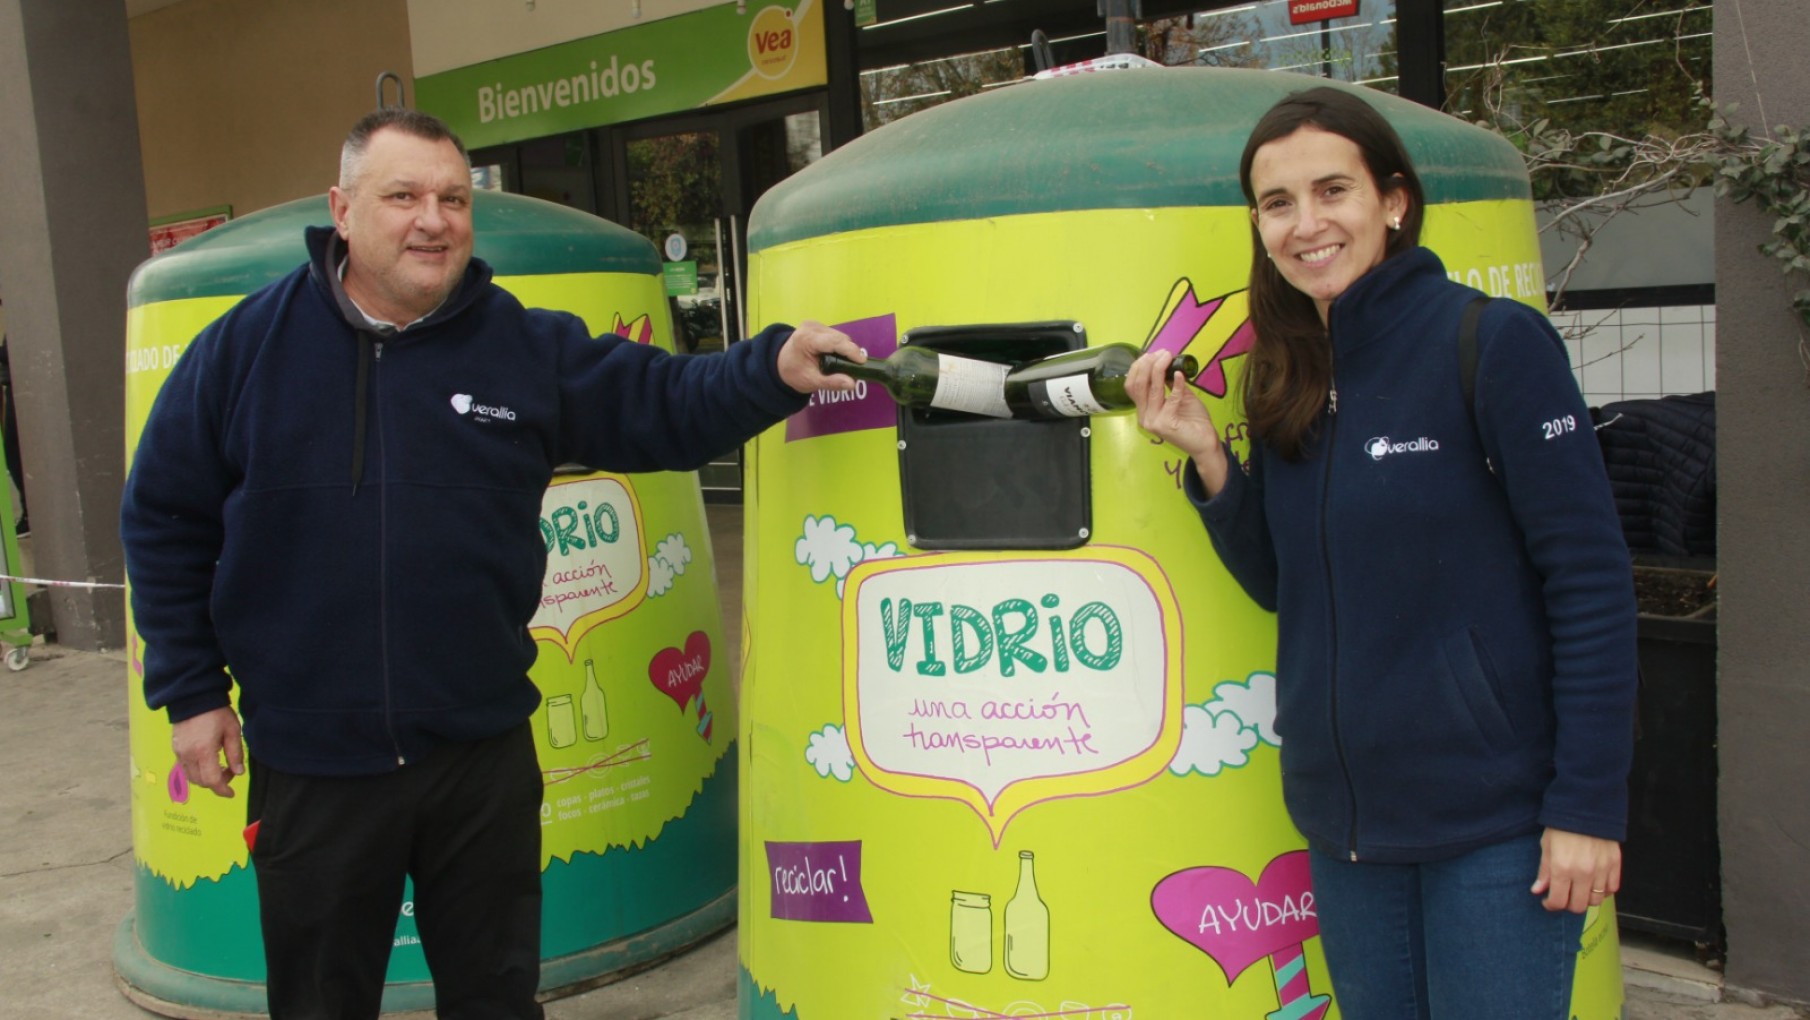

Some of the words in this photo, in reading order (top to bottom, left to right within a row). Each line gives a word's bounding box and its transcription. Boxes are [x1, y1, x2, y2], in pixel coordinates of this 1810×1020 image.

[755, 29, 792, 54] Vea
[478, 55, 656, 124] Bienvenidos
[472, 403, 516, 421] verallia
[1542, 414, 1577, 440] 2019
[1387, 437, 1439, 454] verallia
[552, 560, 612, 585] acción
[540, 579, 618, 614] nsparente
[667, 654, 705, 689] AYUDAR
[908, 698, 972, 720] una
[981, 691, 1091, 729] acción
[902, 721, 1100, 767] transparente
[1199, 891, 1318, 935] AYUDAR
